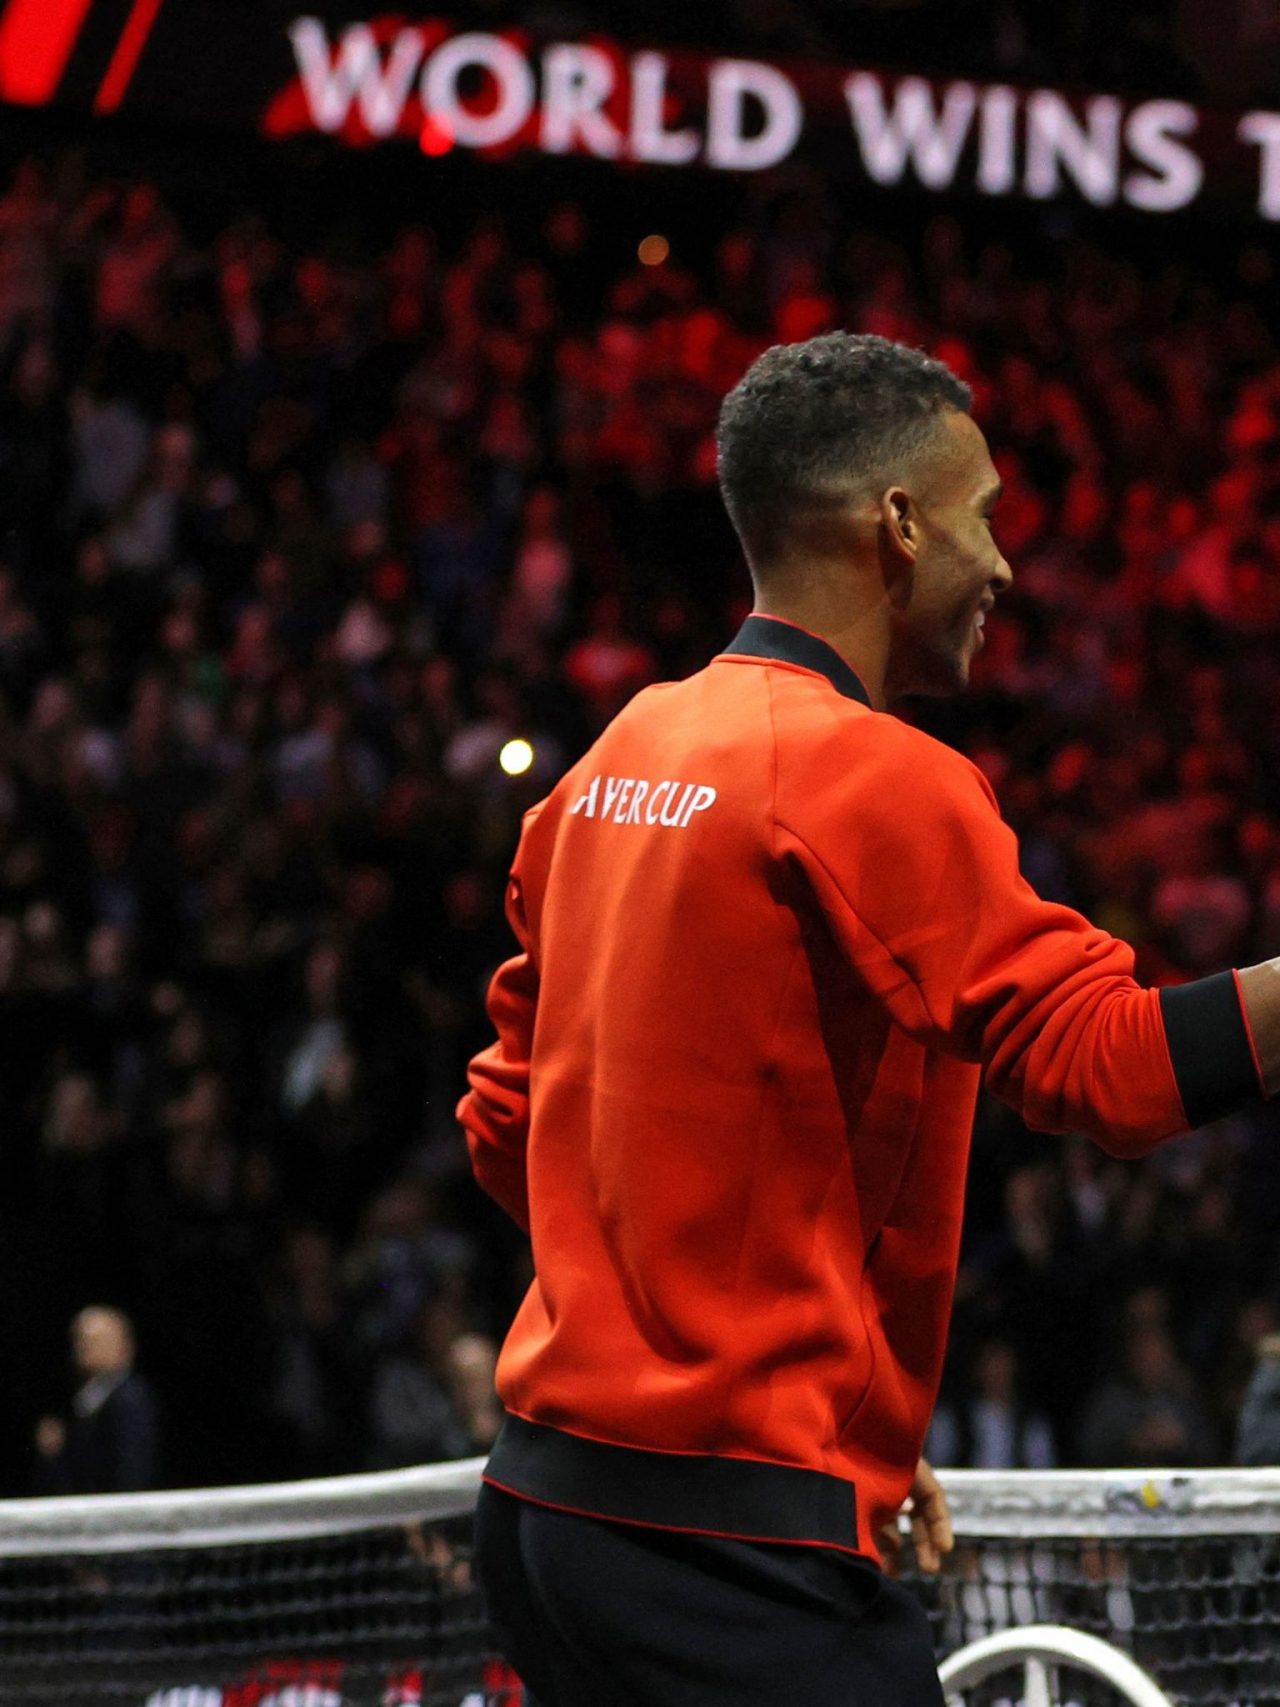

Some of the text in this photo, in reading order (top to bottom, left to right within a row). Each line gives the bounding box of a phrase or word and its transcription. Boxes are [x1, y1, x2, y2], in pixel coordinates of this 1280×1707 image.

[293, 18, 801, 169] WORLD
[846, 76, 1201, 211] WINS
[570, 775, 717, 828] AVER CUP
